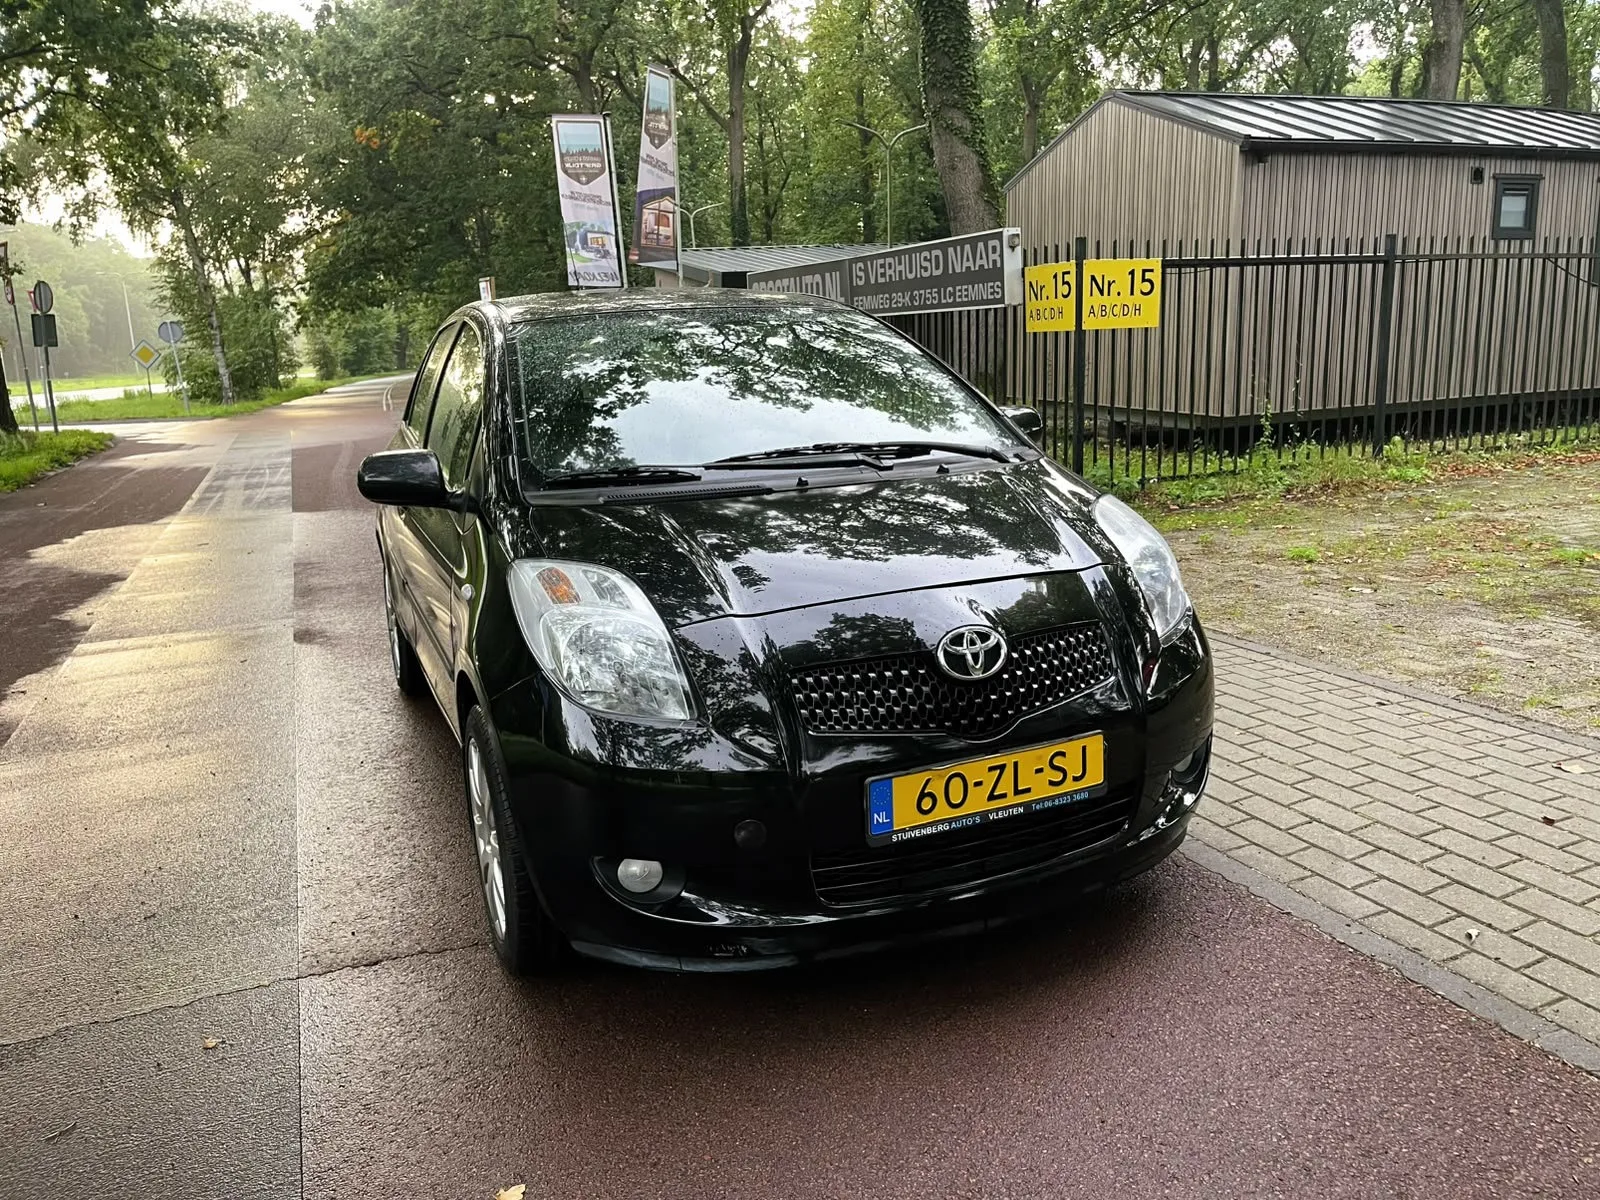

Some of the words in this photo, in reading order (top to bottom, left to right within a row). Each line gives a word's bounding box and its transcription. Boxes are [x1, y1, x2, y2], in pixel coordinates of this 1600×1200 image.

[852, 262, 866, 286] IS
[867, 250, 943, 283] VERHUISD
[947, 238, 1001, 274] NAAR
[752, 271, 845, 303] TAUTONL
[853, 293, 890, 310] EEMWEG
[891, 291, 911, 308] 29-K
[913, 288, 938, 305] 3755
[940, 286, 954, 304] LC
[955, 281, 1002, 302] EEMNES
[1029, 279, 1049, 302] Nr.
[1052, 270, 1072, 300] 15
[1089, 274, 1121, 297] Nr.
[1128, 268, 1155, 297] 15
[1088, 303, 1142, 319] A/B/C/D/H
[915, 745, 1088, 816] 60-ZL-SJ
[873, 811, 890, 825] NL
[891, 822, 950, 843] STUIVENBERG
[951, 815, 981, 830] AUTO'S
[988, 806, 1024, 821] VLEUTEN
[1072, 791, 1089, 802] 3680
